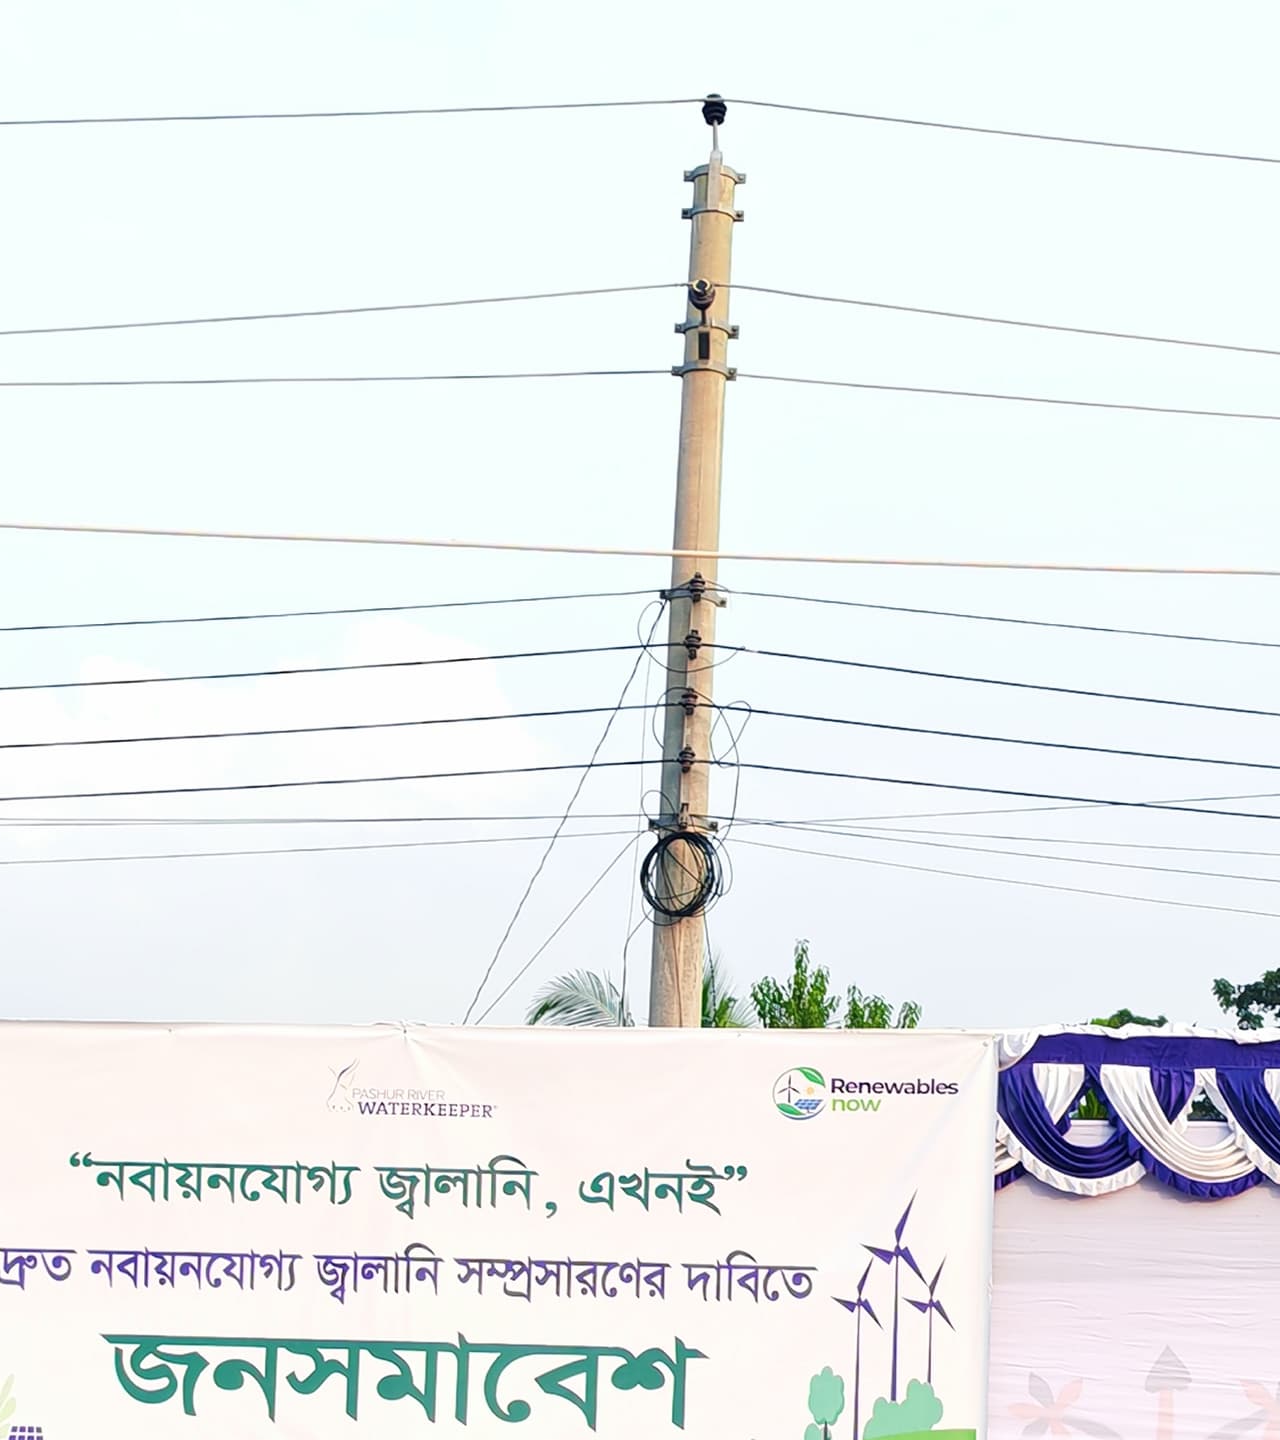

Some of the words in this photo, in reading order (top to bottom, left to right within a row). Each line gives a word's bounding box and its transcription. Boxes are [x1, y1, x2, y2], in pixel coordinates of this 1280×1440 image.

[351, 1088, 405, 1100] PASHUR
[407, 1089, 446, 1101] RIVER
[830, 1078, 959, 1095] Renewables
[357, 1101, 494, 1118] WATERKEEPER
[832, 1098, 882, 1113] now
[86, 1246, 303, 1291] নবায়নযোগ্য
[312, 1242, 445, 1305] জ্বালানি
[453, 1256, 672, 1303] সম্প্রসারণের
[680, 1250, 818, 1304] দাবিতে
[99, 1331, 710, 1432] জনসমাবেশ
